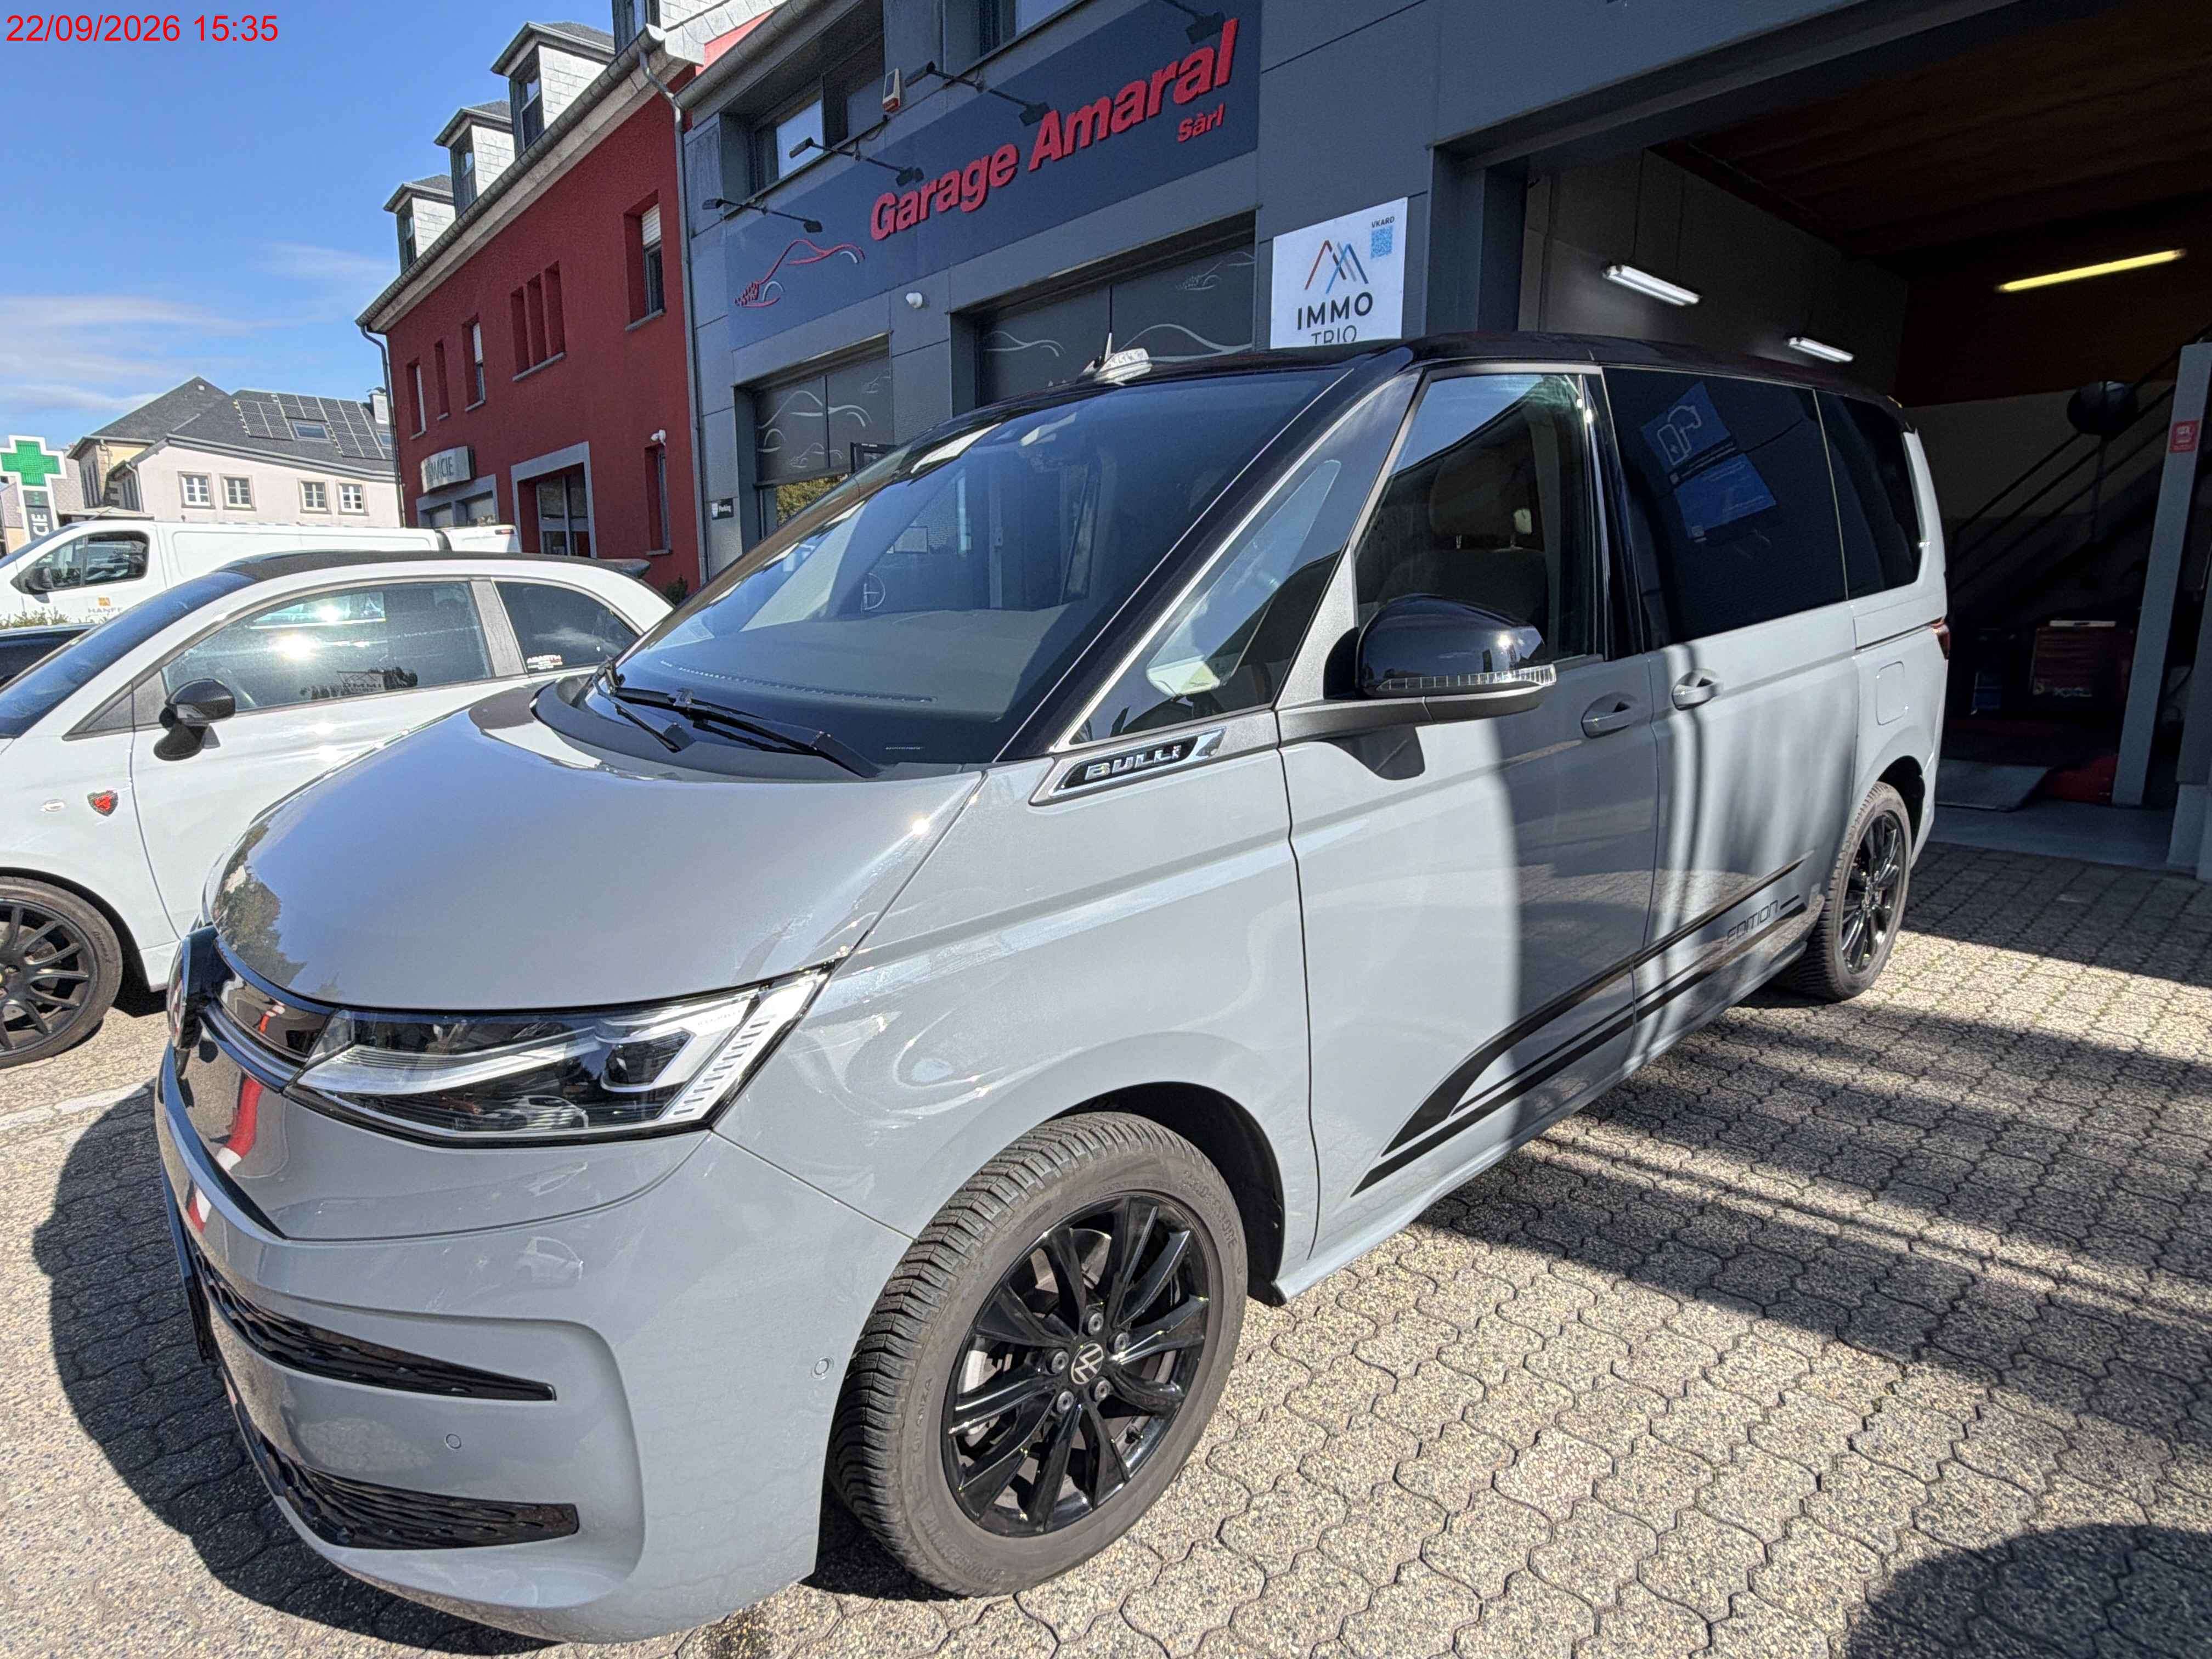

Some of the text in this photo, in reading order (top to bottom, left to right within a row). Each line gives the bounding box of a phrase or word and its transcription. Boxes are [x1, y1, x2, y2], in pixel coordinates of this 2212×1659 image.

[871, 19, 1238, 241] Garage Amaral
[1177, 103, 1224, 142] Sàrl
[1372, 216, 1395, 228] VKARD
[1297, 292, 1373, 330] IMMO
[1311, 325, 1357, 344] TRIO
[1085, 744, 1182, 780] BULLI
